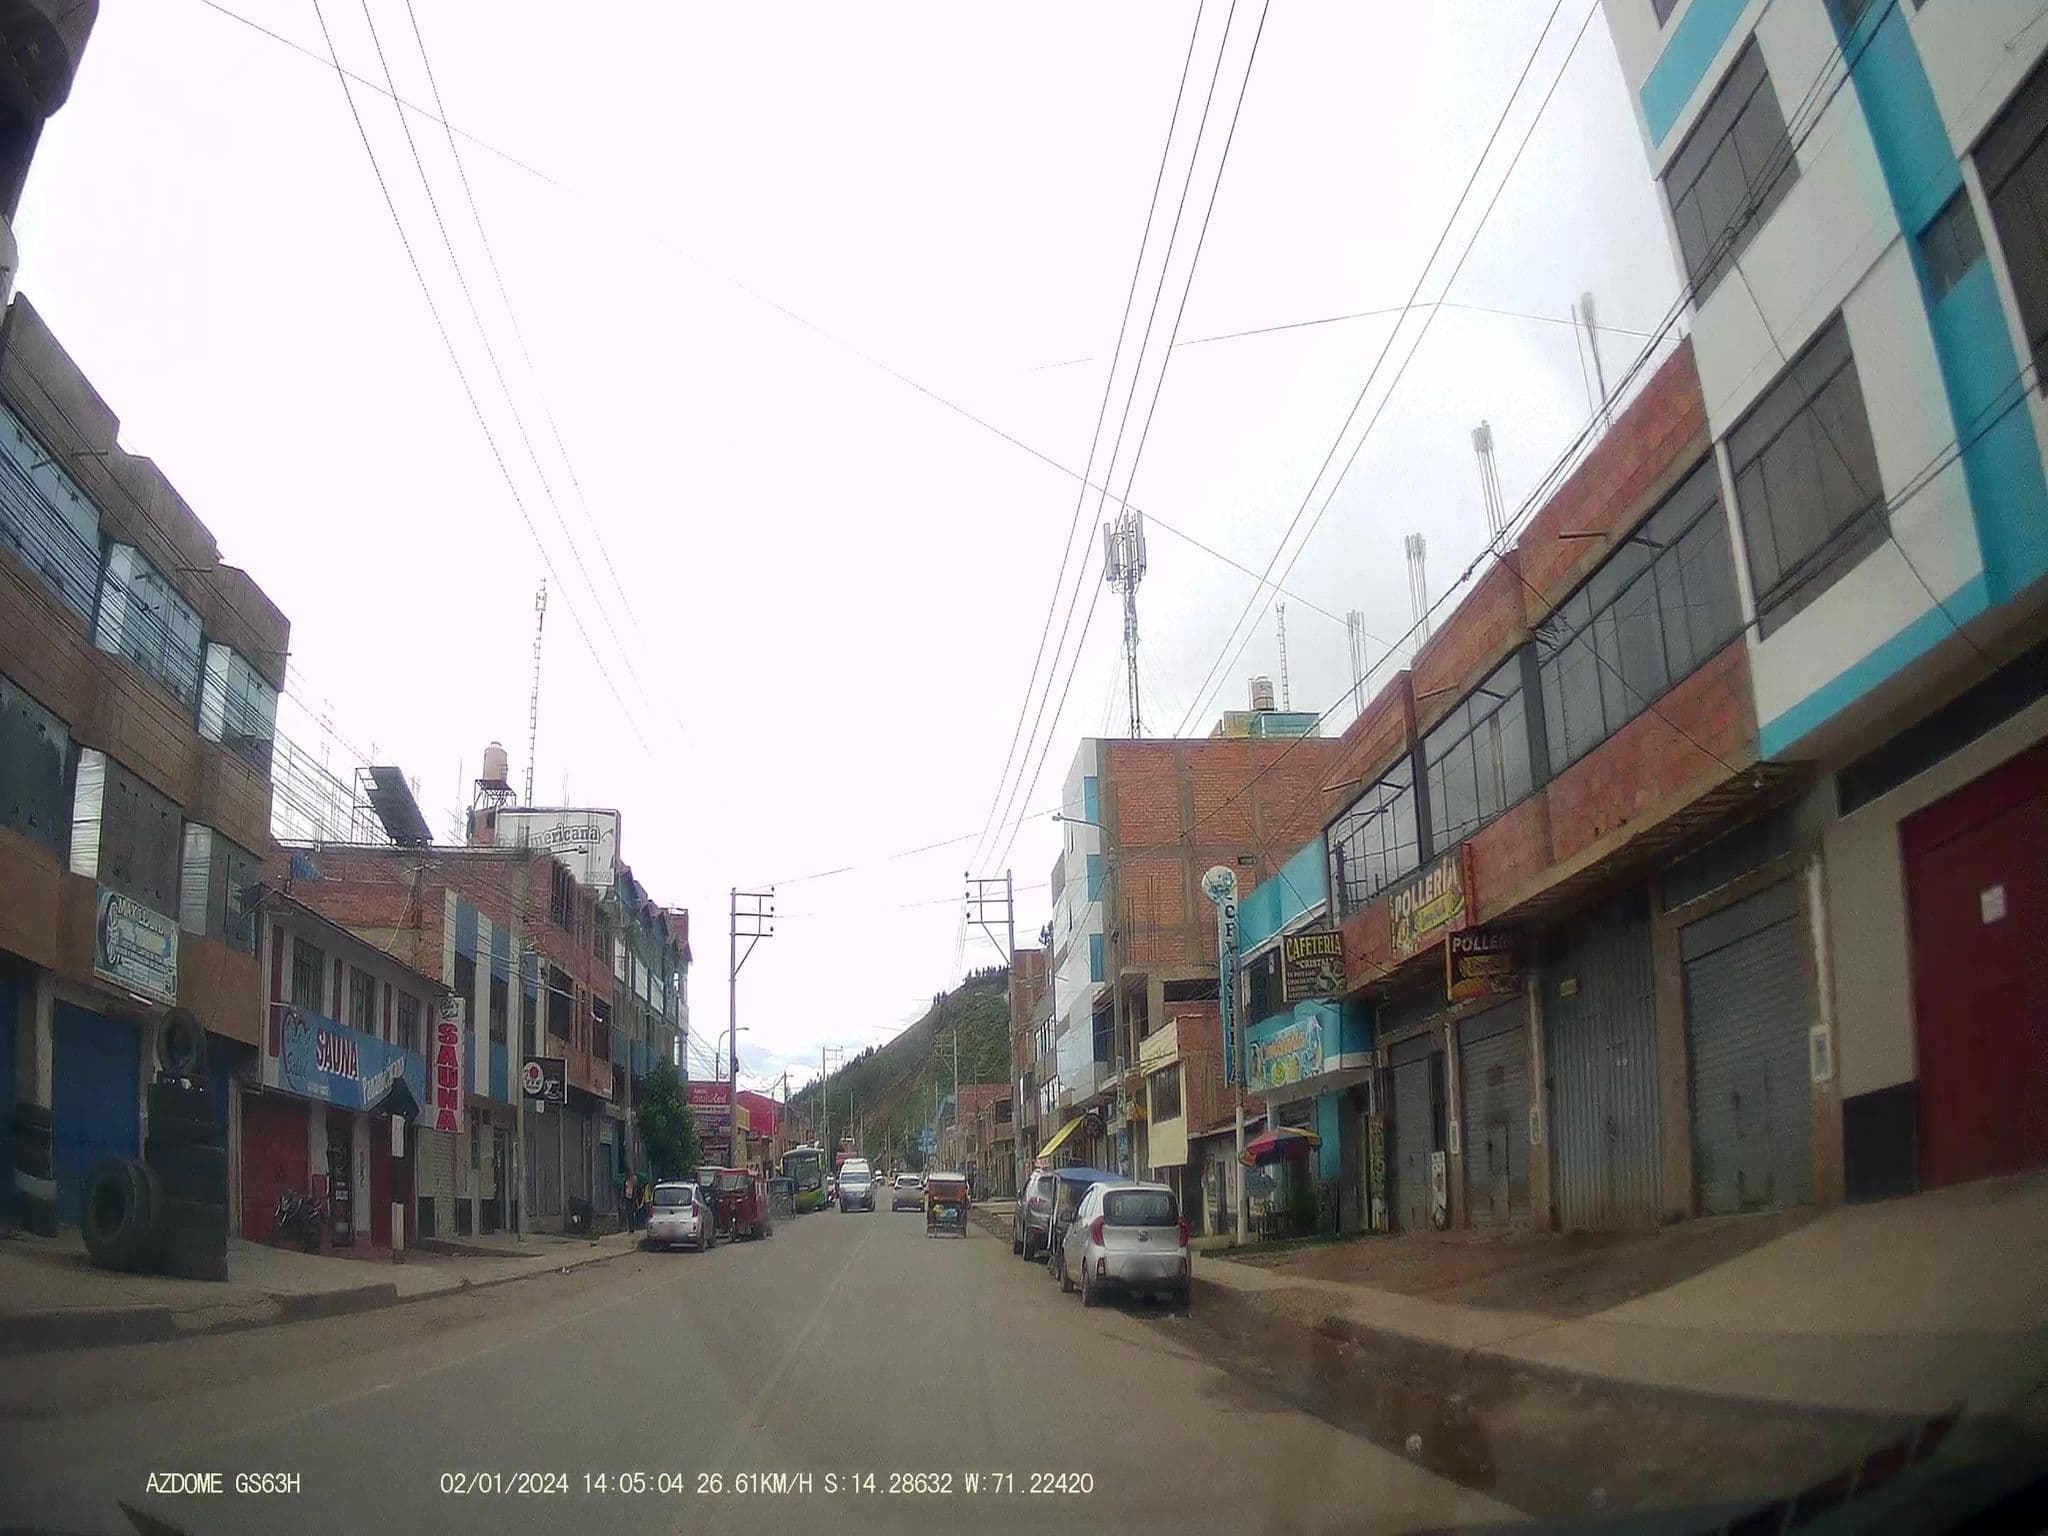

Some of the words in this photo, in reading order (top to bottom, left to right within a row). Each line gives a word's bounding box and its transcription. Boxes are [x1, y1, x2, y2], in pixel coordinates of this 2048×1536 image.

[1286, 934, 1342, 962] CAFETERIA
[1452, 934, 1514, 953] POLLER
[315, 1028, 360, 1081] SAUNA
[436, 1022, 459, 1131] SAUNA
